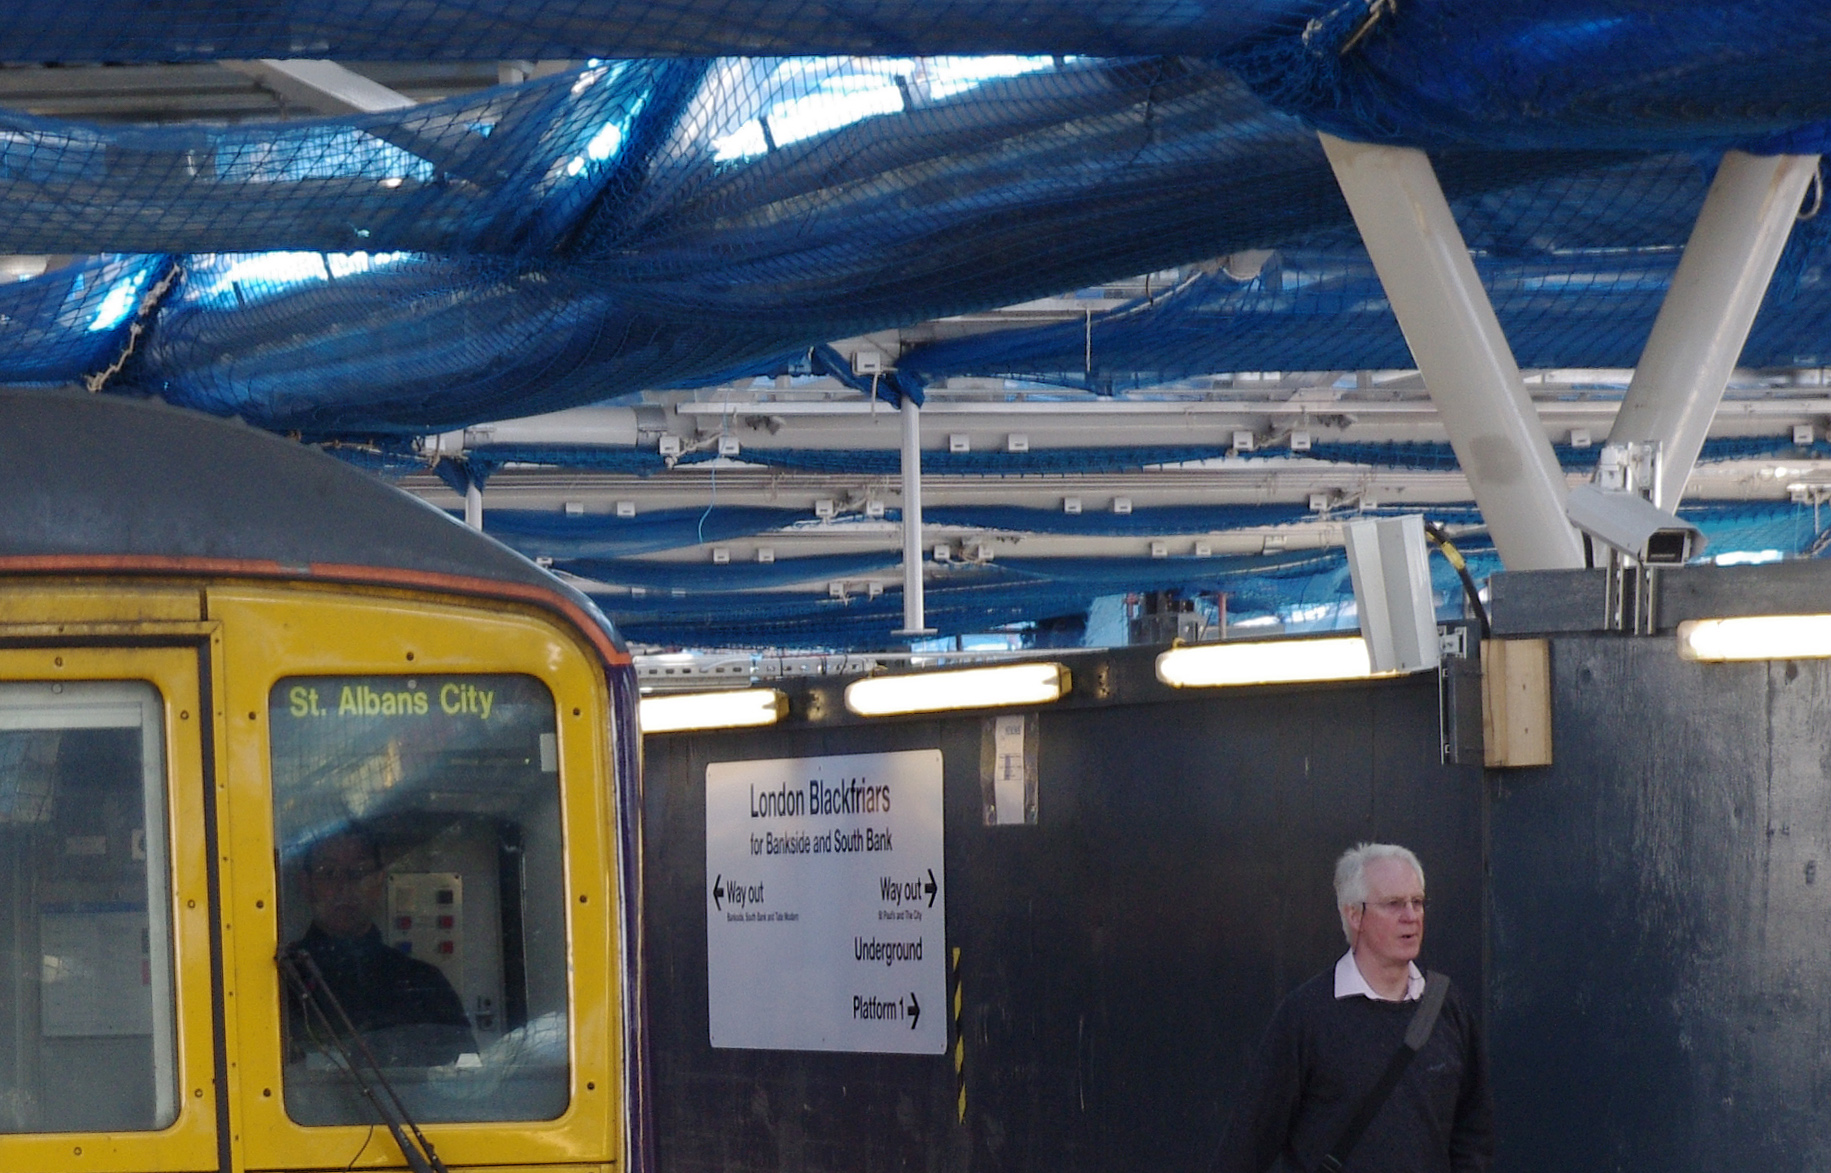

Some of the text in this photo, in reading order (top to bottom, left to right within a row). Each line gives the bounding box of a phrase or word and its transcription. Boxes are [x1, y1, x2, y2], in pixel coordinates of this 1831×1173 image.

[289, 683, 495, 720] St. Albans City
[750, 777, 891, 818] London Blackfriars
[750, 827, 893, 855] for Bankside and South Bank
[726, 881, 764, 908] Way out
[880, 877, 922, 906] Way out
[854, 936, 923, 966] Underground
[853, 995, 904, 1021] Platform 1
